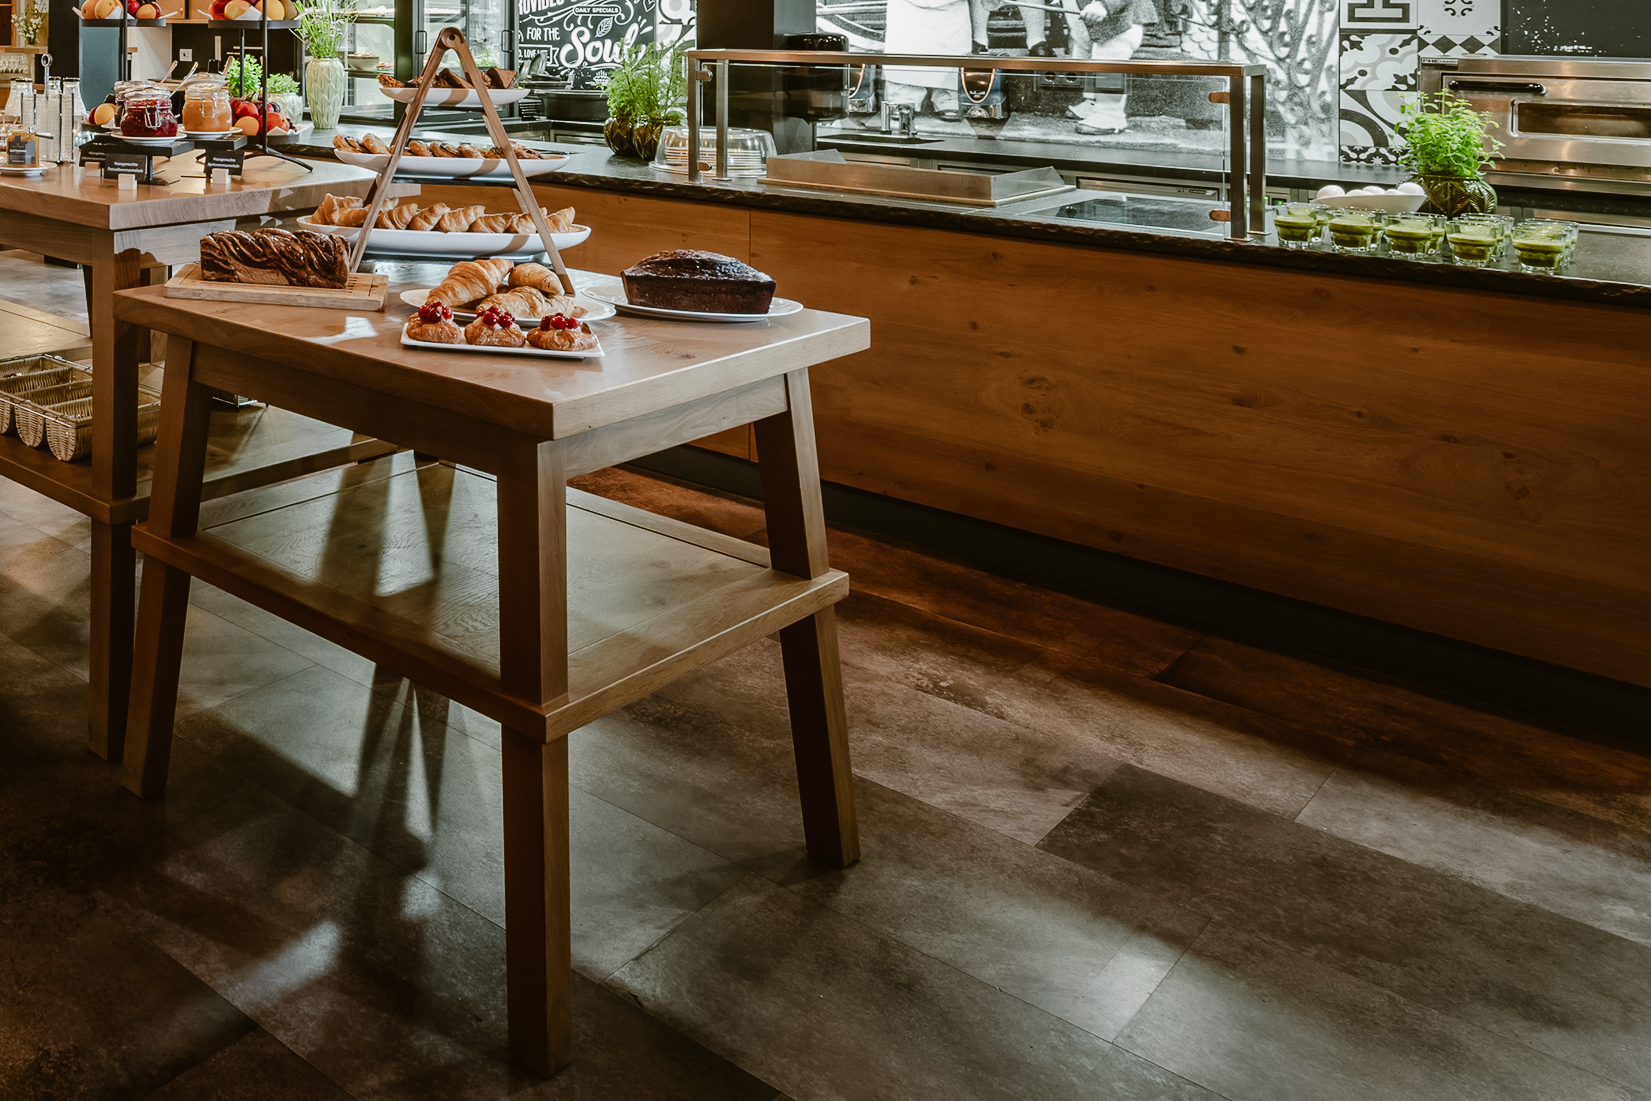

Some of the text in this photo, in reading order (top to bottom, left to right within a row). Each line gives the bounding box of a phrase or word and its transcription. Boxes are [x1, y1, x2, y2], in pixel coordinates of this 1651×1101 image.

[574, 6, 619, 14] DAILY SPECIALS
[526, 27, 561, 41] FOR THE
